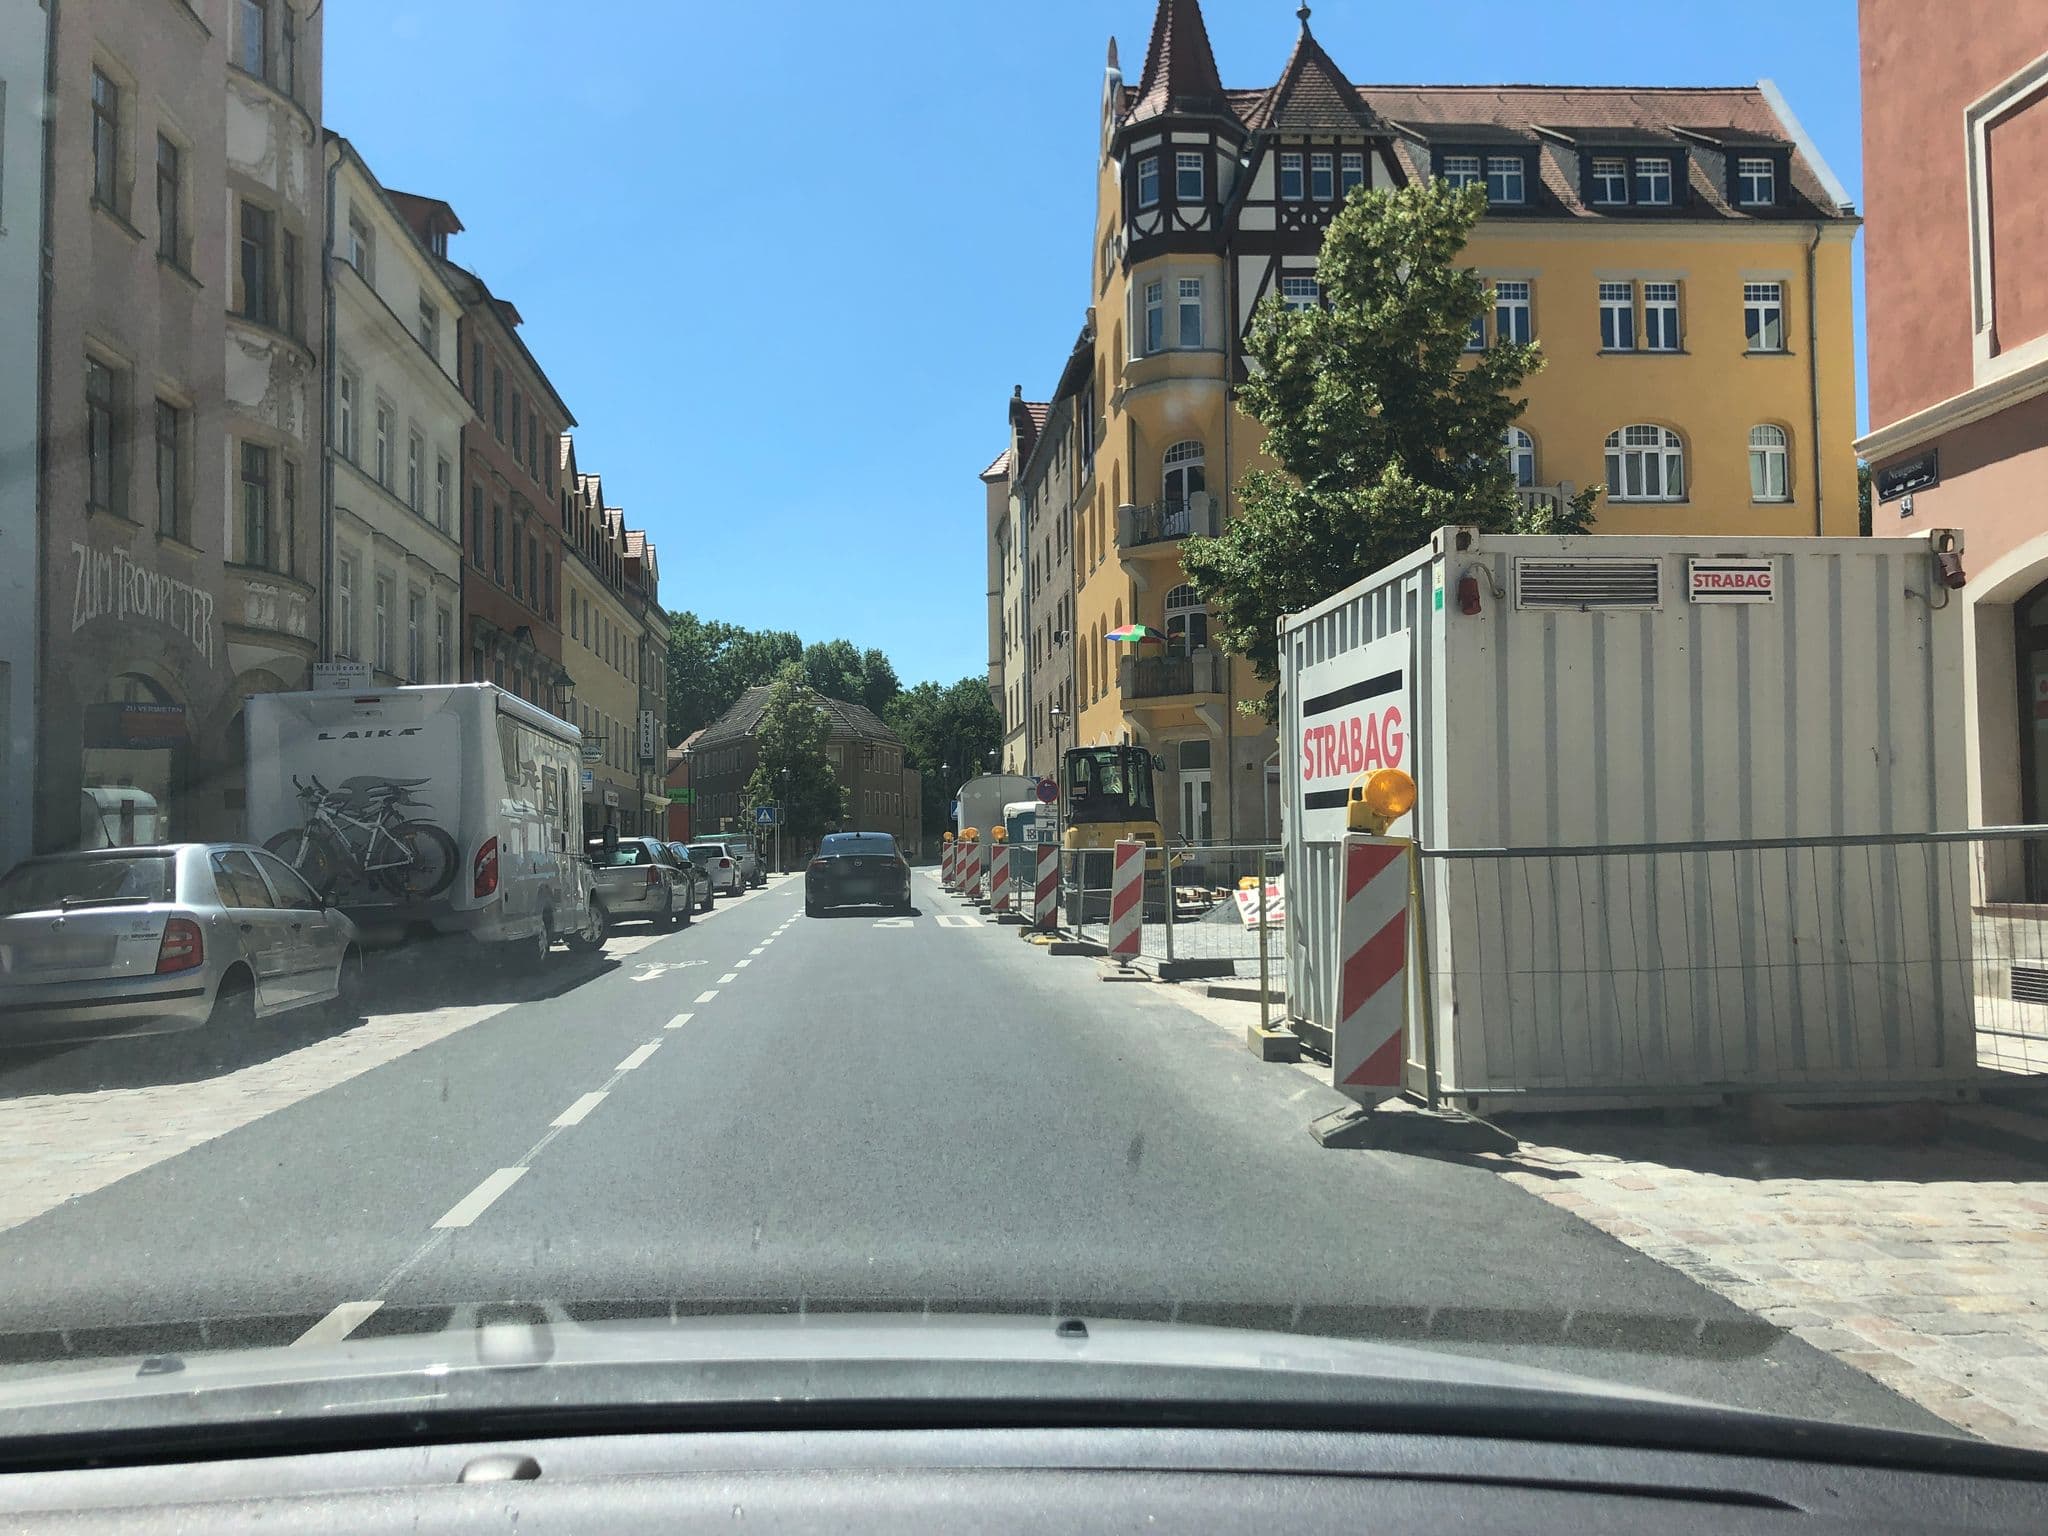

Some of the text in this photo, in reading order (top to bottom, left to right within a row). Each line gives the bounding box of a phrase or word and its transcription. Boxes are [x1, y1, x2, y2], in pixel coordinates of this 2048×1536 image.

[1693, 573, 1771, 588] STRABAG
[71, 540, 214, 671] ZUM TROMPETER
[317, 727, 423, 741] LAIKA
[643, 711, 651, 755] PENSION
[1303, 705, 1404, 781] STRABAG
